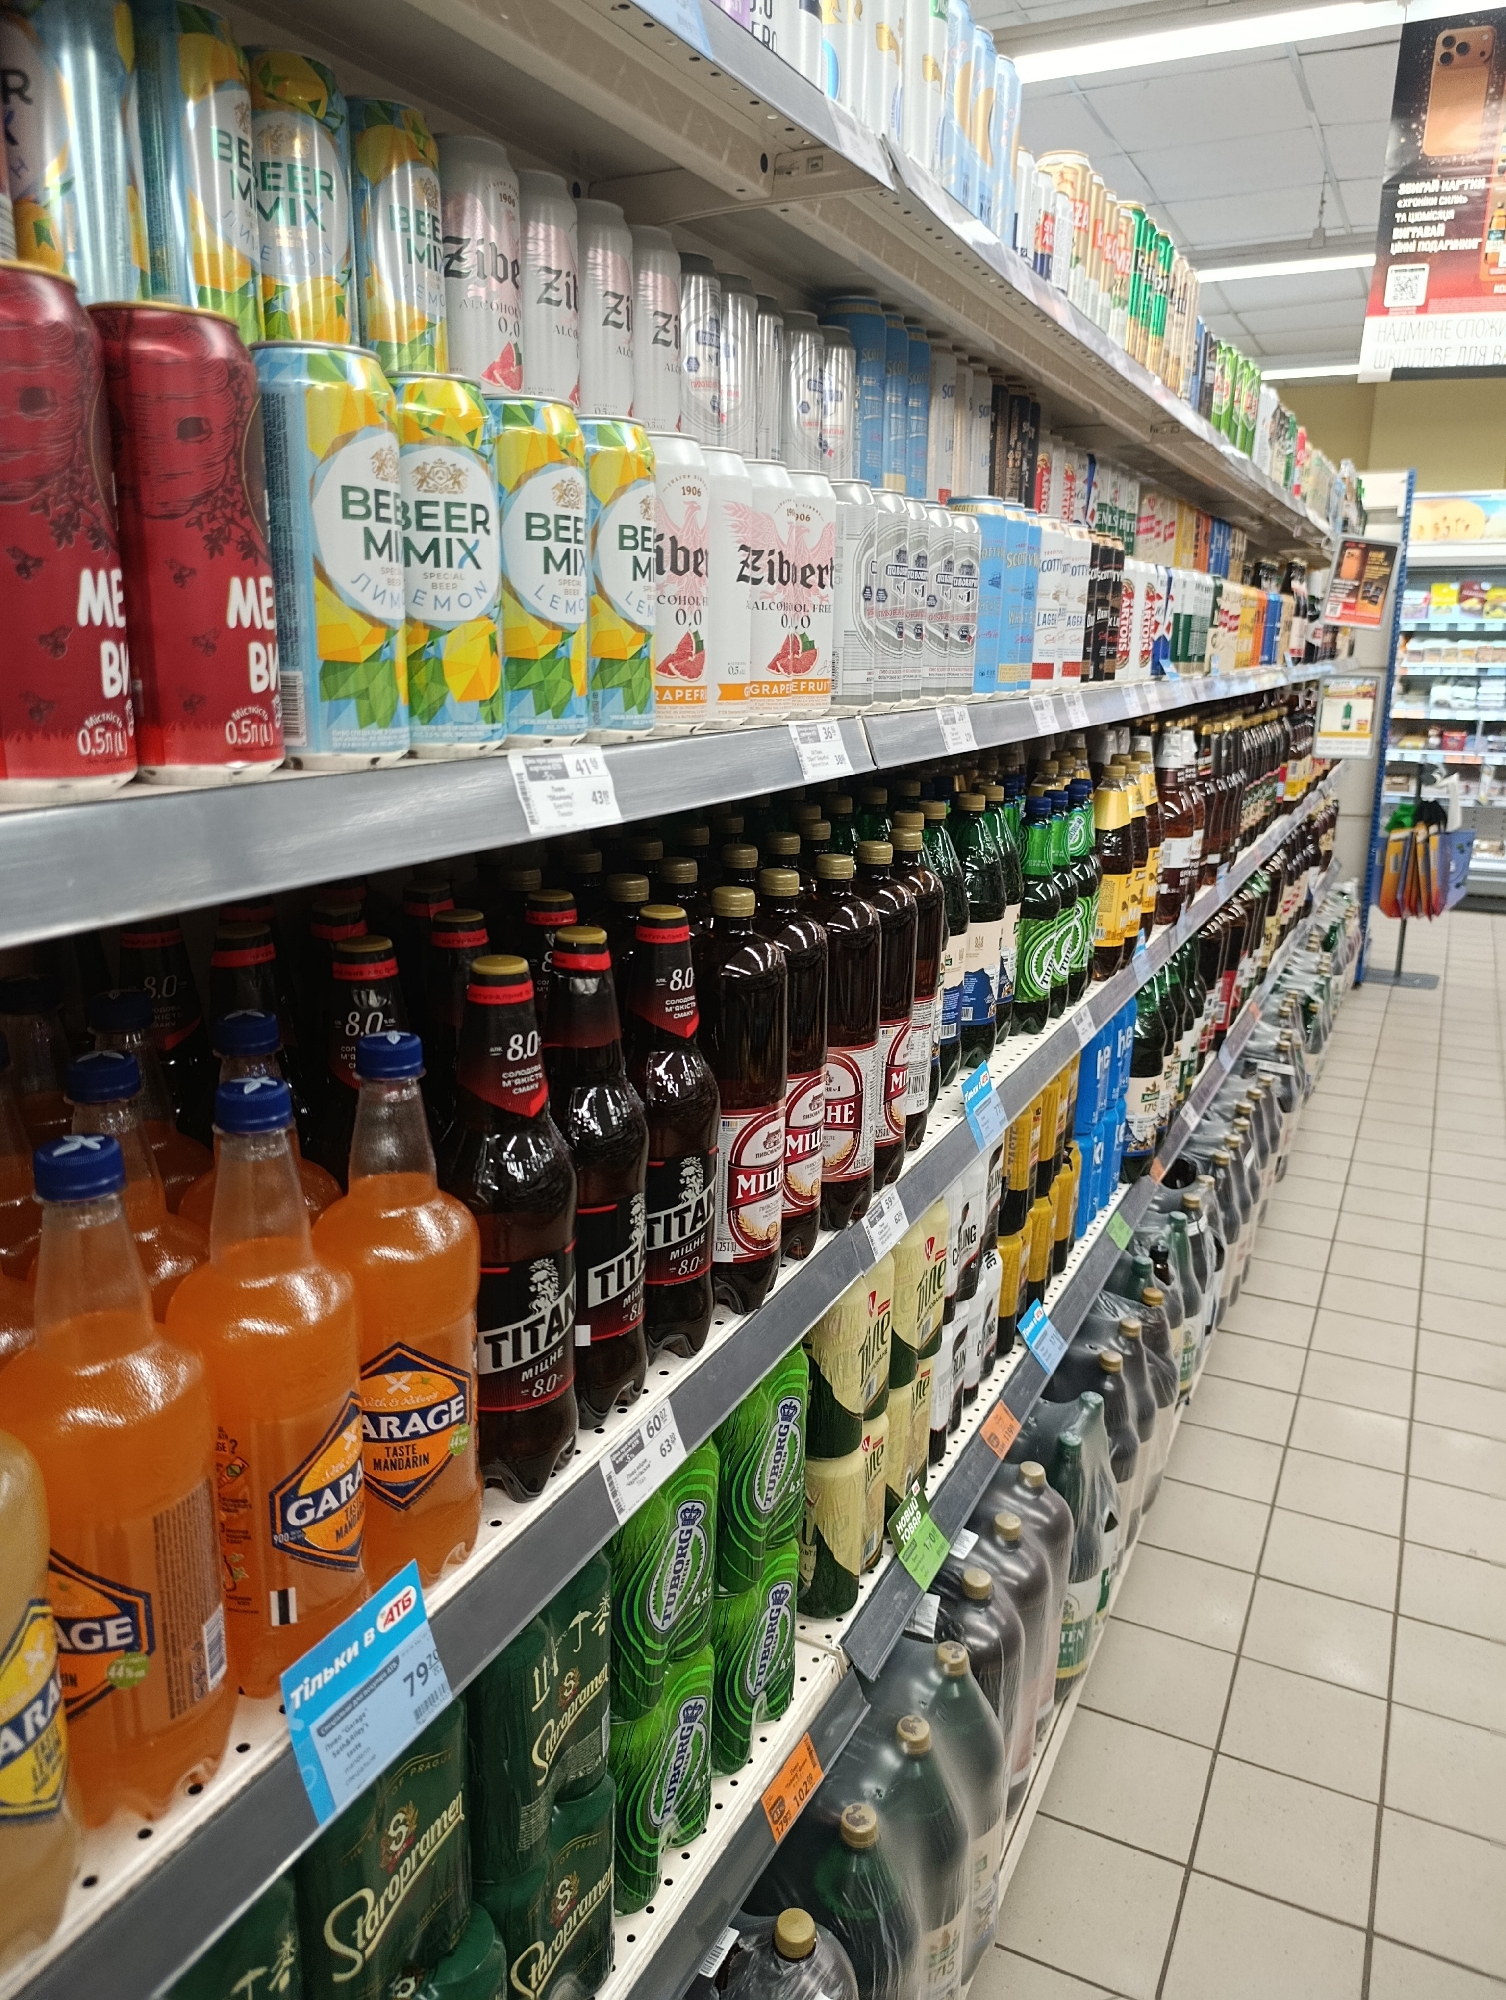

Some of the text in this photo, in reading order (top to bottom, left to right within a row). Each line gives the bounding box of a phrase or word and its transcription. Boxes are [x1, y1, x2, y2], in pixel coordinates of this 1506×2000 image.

[1377, 319, 1452, 343] НАДМІРНЕ
[1373, 346, 1452, 370] ШКІДЛИВЕ
[1457, 346, 1488, 367] ДЛЯ
[682, 485, 702, 498] 1906
[403, 536, 482, 571] MIX
[423, 572, 466, 582] SPECIAL
[431, 582, 459, 591] BEER
[675, 608, 703, 628] 0,0
[1119, 598, 1130, 652] ARTOIS
[84, 711, 123, 730] Місткість
[231, 705, 270, 722] Місткість
[665, 995, 696, 1006] СОЛОДОВА
[673, 1010, 694, 1019] СМАКУ
[502, 1064, 542, 1079] СОЛОДОВА
[512, 1082, 539, 1095] СМАКУ
[669, 1232, 706, 1261] МІЦНЕ
[521, 1345, 564, 1382] МІЦНЕ
[645, 1414, 662, 1439] 60
[384, 1443, 418, 1458] TASTE
[659, 1438, 673, 1458] 63
[373, 1452, 430, 1472] MANDARIN
[764, 1424, 791, 1507] TUBORG
[896, 1497, 919, 1536] НОВИЙ
[900, 1510, 922, 1546] ТОВАР
[661, 1528, 693, 1627] TUBORG
[290, 1641, 360, 1710] Тільки
[382, 1589, 414, 1630] АТБ
[753, 1607, 782, 1692] TUBORG
[402, 1661, 430, 1698] 79
[325, 1735, 342, 1752] Пиво
[346, 1742, 362, 1759] taste
[661, 1724, 695, 1821] TUBORG
[794, 1780, 810, 1808] 102
[324, 1789, 466, 1983] Staropramen
